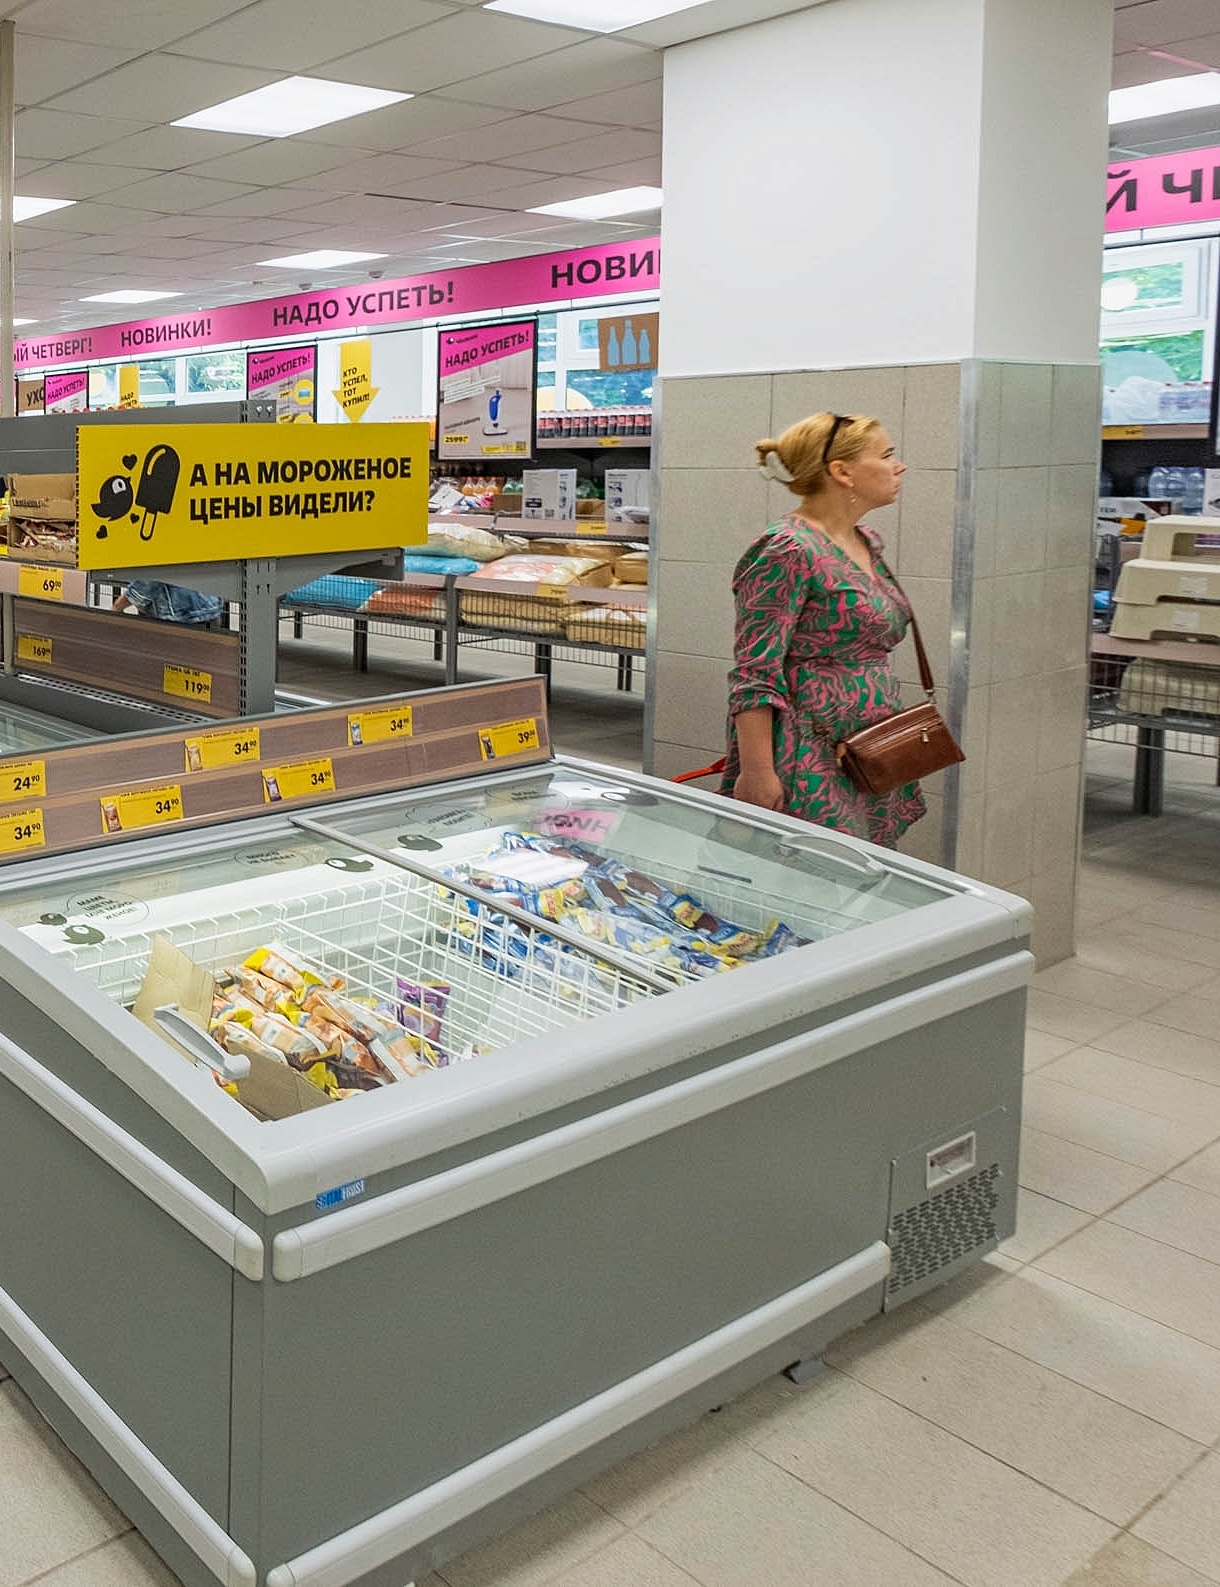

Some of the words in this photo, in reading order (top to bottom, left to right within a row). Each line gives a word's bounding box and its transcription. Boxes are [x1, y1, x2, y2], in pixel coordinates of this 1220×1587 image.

[550, 250, 660, 288] НОВИ
[273, 300, 340, 328] НАДО
[346, 281, 455, 317] УСПЕТЬ!
[32, 337, 93, 360] ЧЕТВЕРГ!
[120, 317, 213, 348] НОВИНКИ!
[444, 347, 479, 368] НАДО
[480, 330, 530, 357] УСПЕТЬ!
[251, 367, 276, 385] НАДО
[276, 352, 311, 374] УСПЕТЬ!
[343, 367, 357, 377] КТО
[343, 388, 357, 398] ТОТ
[189, 463, 209, 487] А
[215, 461, 251, 486] НА
[257, 456, 412, 484] МОРОЖЕНОЕ
[189, 496, 263, 525] ЦЕНЫ
[269, 490, 376, 519] ВИДЕЛИ?
